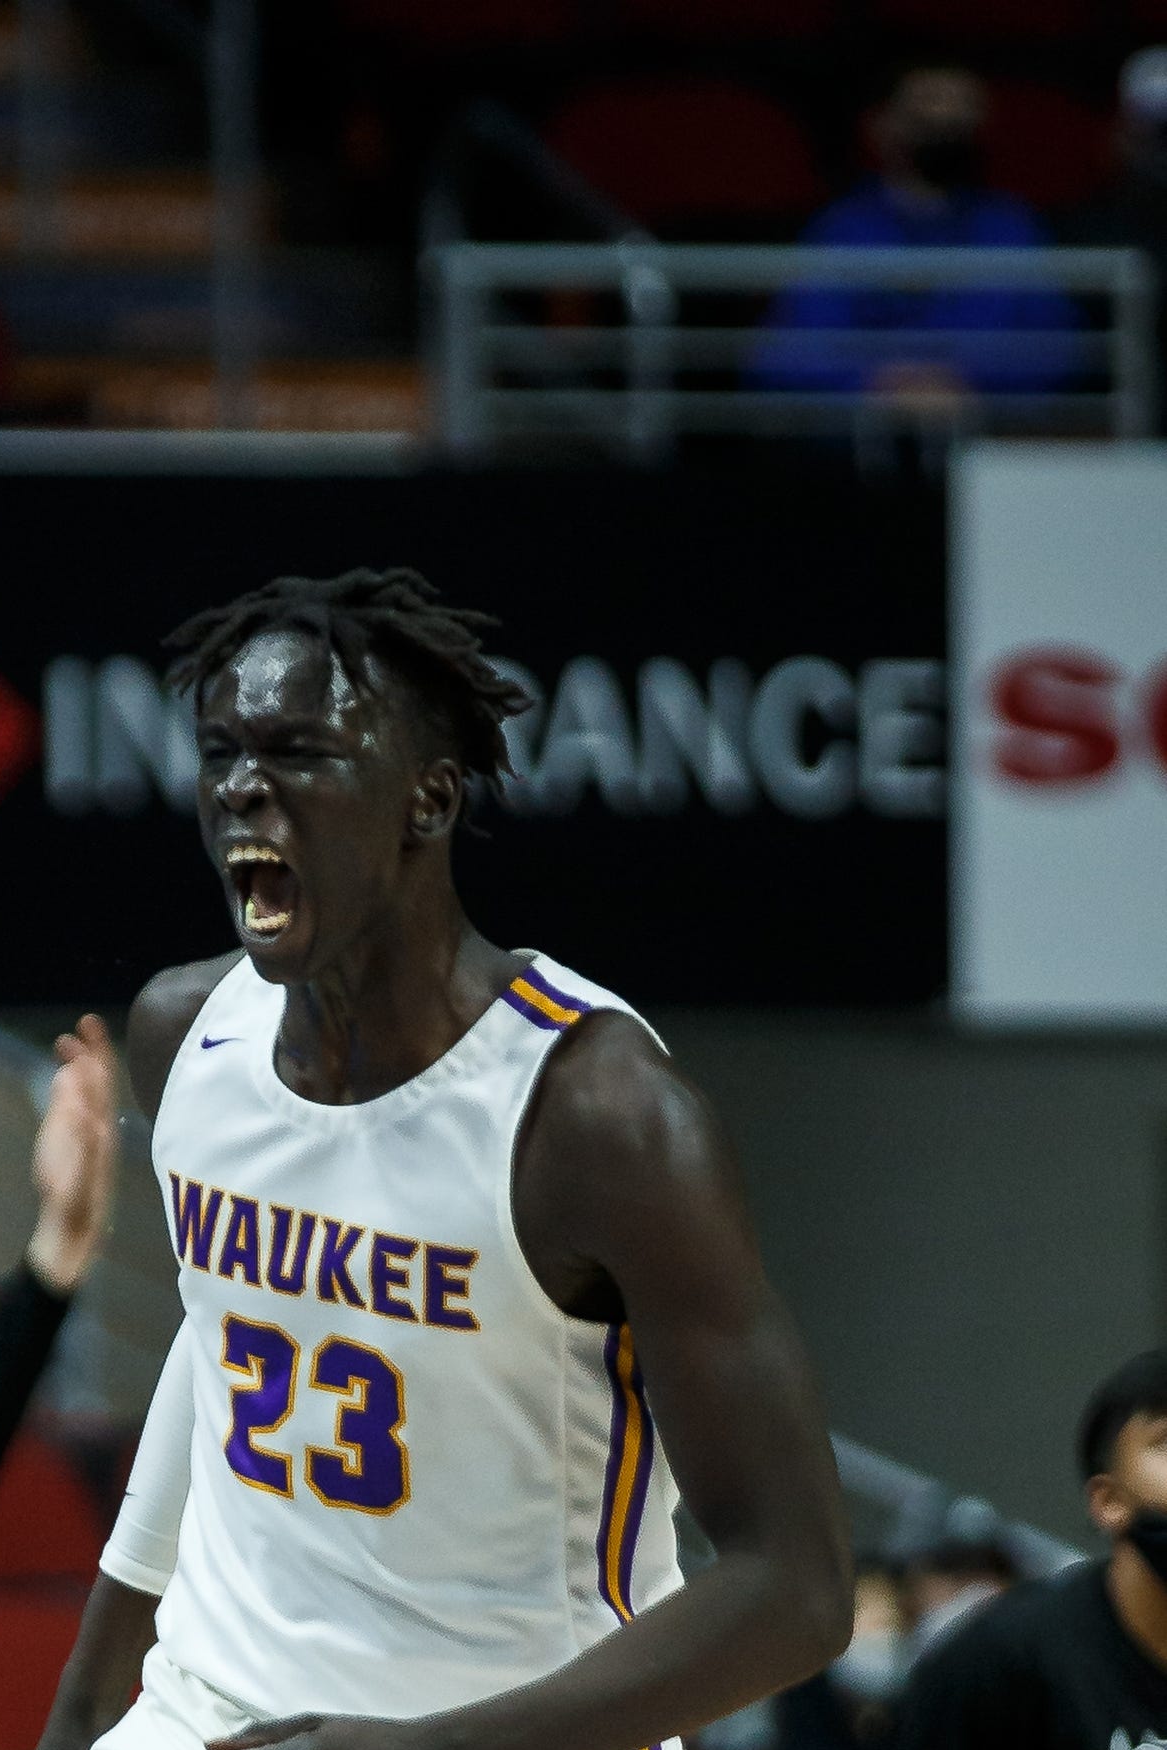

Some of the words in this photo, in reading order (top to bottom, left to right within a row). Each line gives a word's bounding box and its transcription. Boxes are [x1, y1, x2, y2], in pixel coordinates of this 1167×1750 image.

[43, 657, 946, 813] INANCE
[985, 648, 1167, 798] S
[168, 1168, 481, 1334] WAUKEE
[221, 1309, 412, 1519] 23
